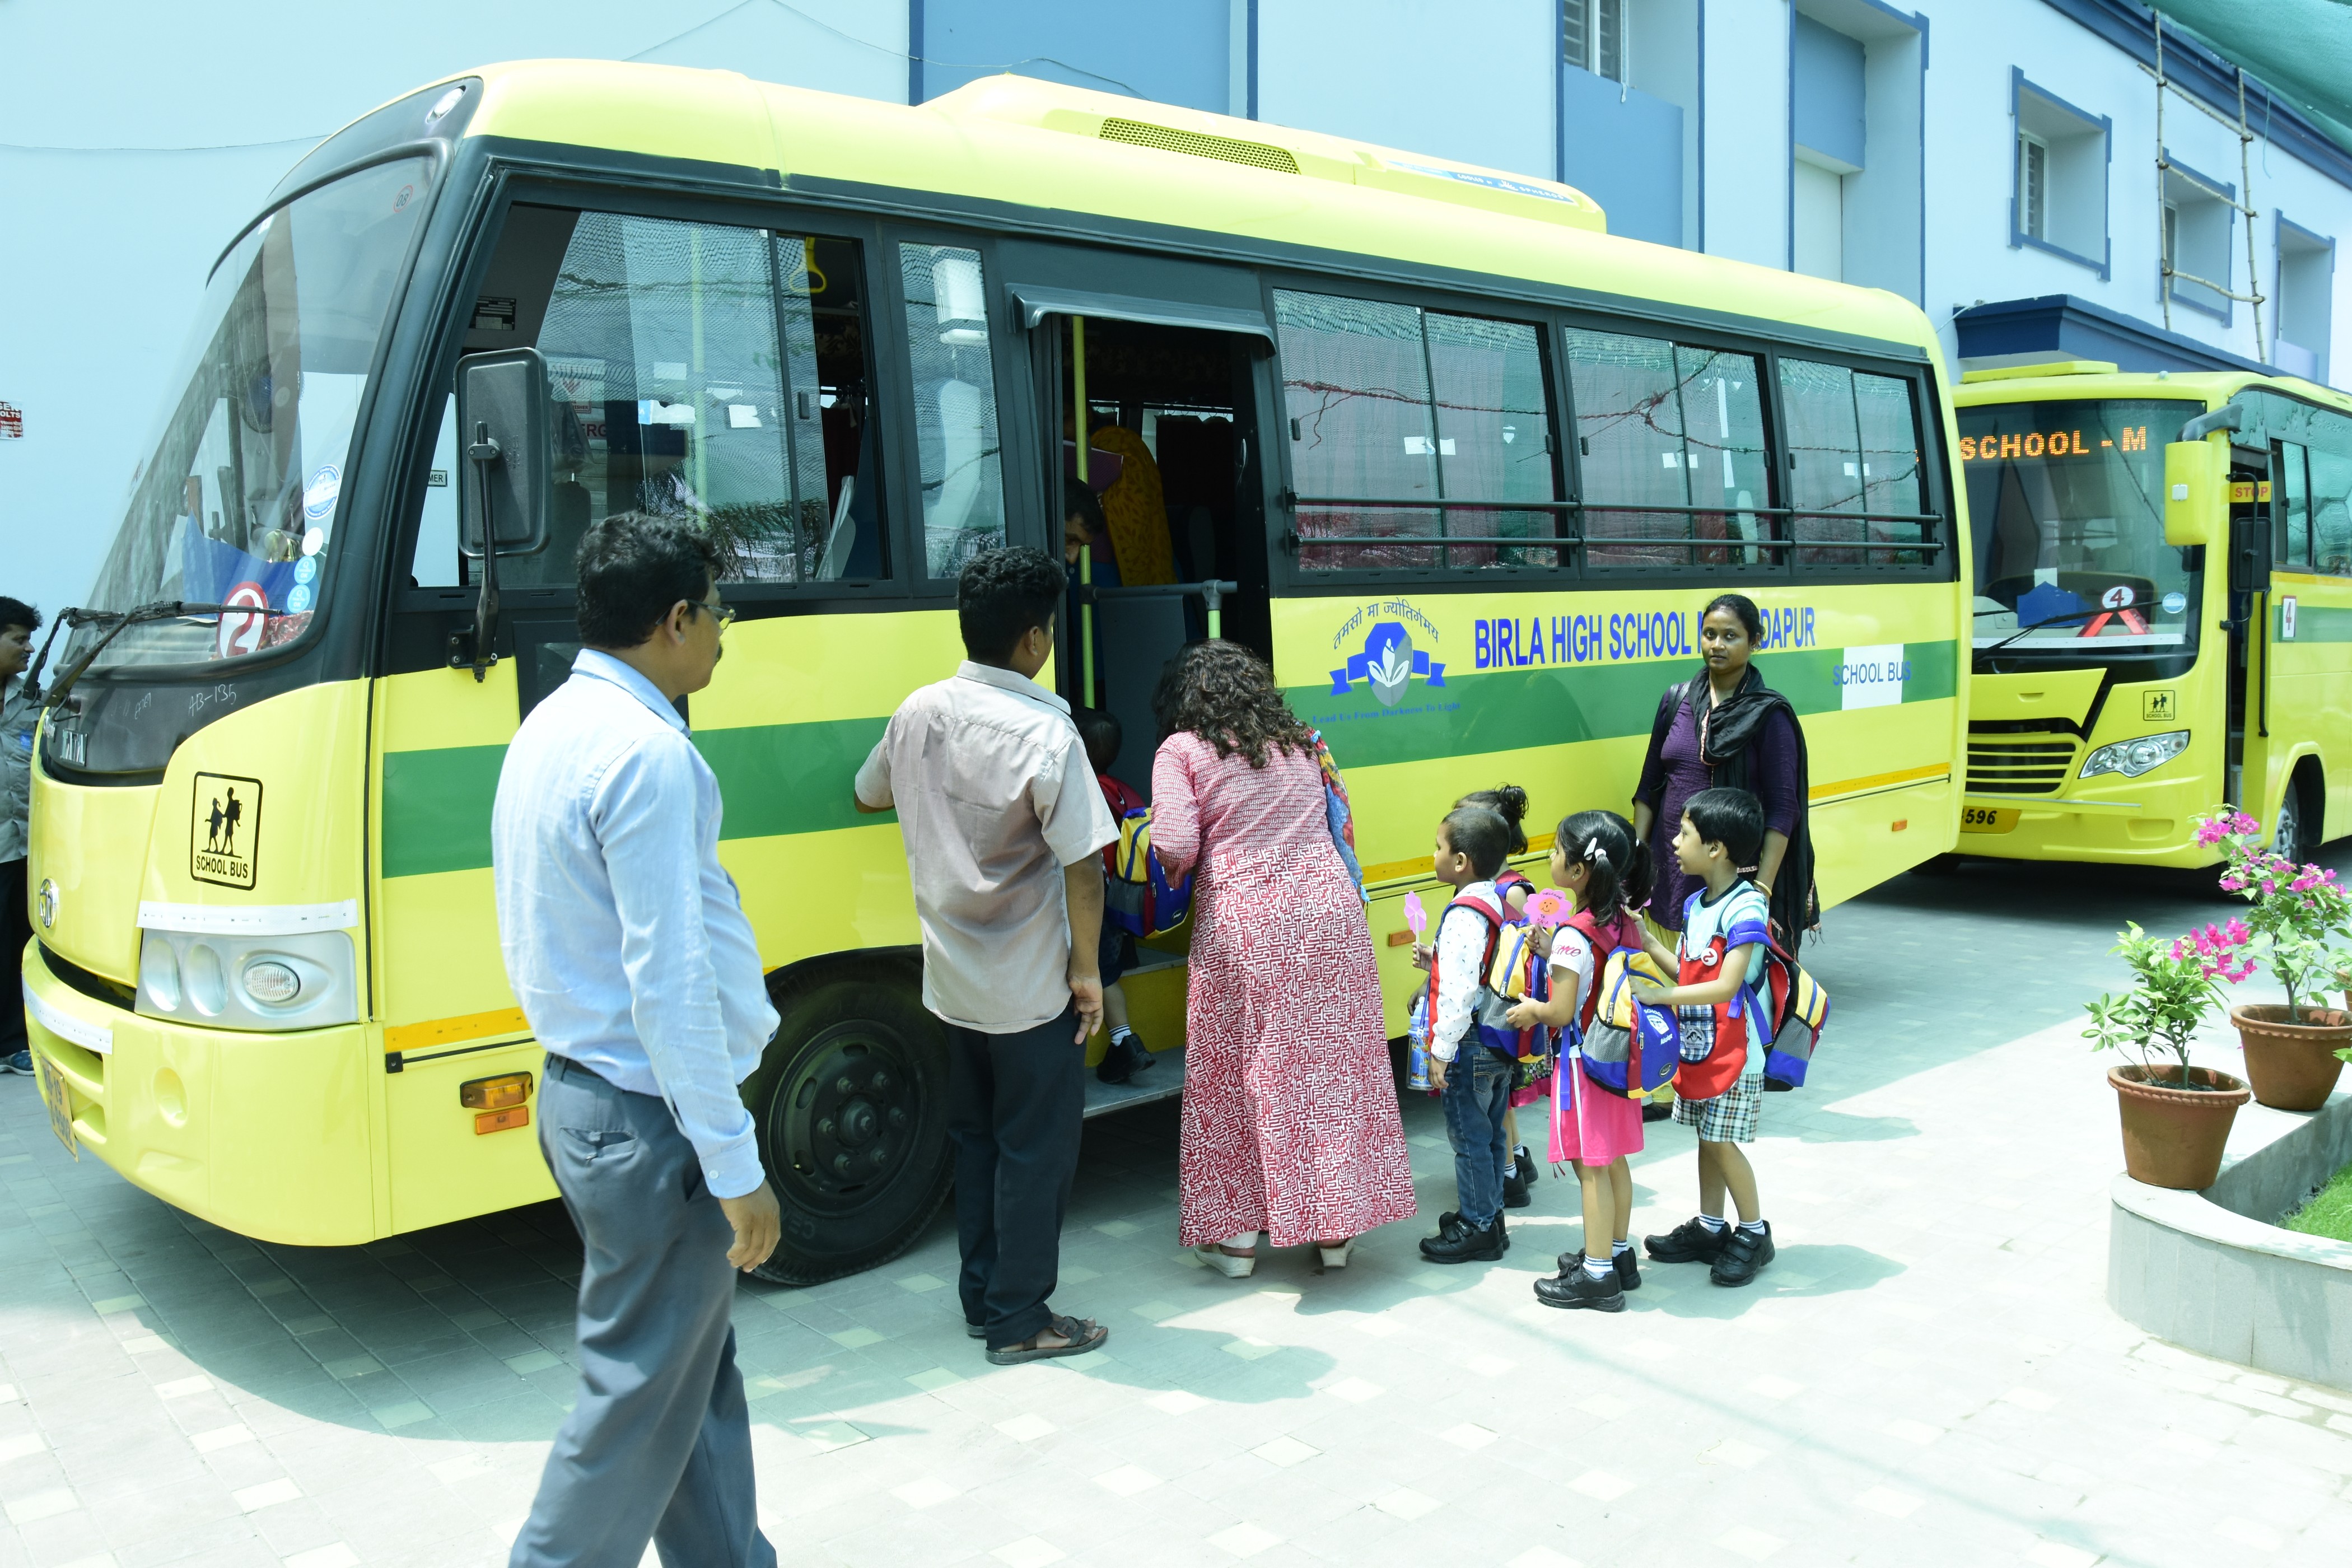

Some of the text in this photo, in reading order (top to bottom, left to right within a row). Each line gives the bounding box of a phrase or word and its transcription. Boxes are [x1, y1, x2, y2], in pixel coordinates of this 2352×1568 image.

[1959, 430, 2089, 460] SCHOOL
[2122, 426, 2146, 451] M
[2235, 487, 2268, 498] STOP
[2110, 589, 2125, 607] 4
[226, 594, 255, 657] 2
[1333, 606, 1363, 650] तमसो
[1366, 603, 1379, 618] मा
[2285, 601, 2292, 631] 4
[1474, 617, 1546, 669] BIRLA
[1552, 615, 1602, 664] HIGH
[1609, 611, 1692, 660] SCHOOL
[1833, 660, 1912, 686] SCHOOL BUS
[1313, 713, 1336, 724] Lead
[1354, 711, 1379, 720] From
[1382, 706, 1423, 717] Darkness
[1426, 703, 1435, 712] To
[1438, 702, 1461, 711] Light
[1961, 808, 1998, 825] 596
[196, 855, 248, 879] SCHOOL BUS
[1542, 892, 1563, 900] WELCOME
[1644, 1009, 1664, 1019] SCHOOL
